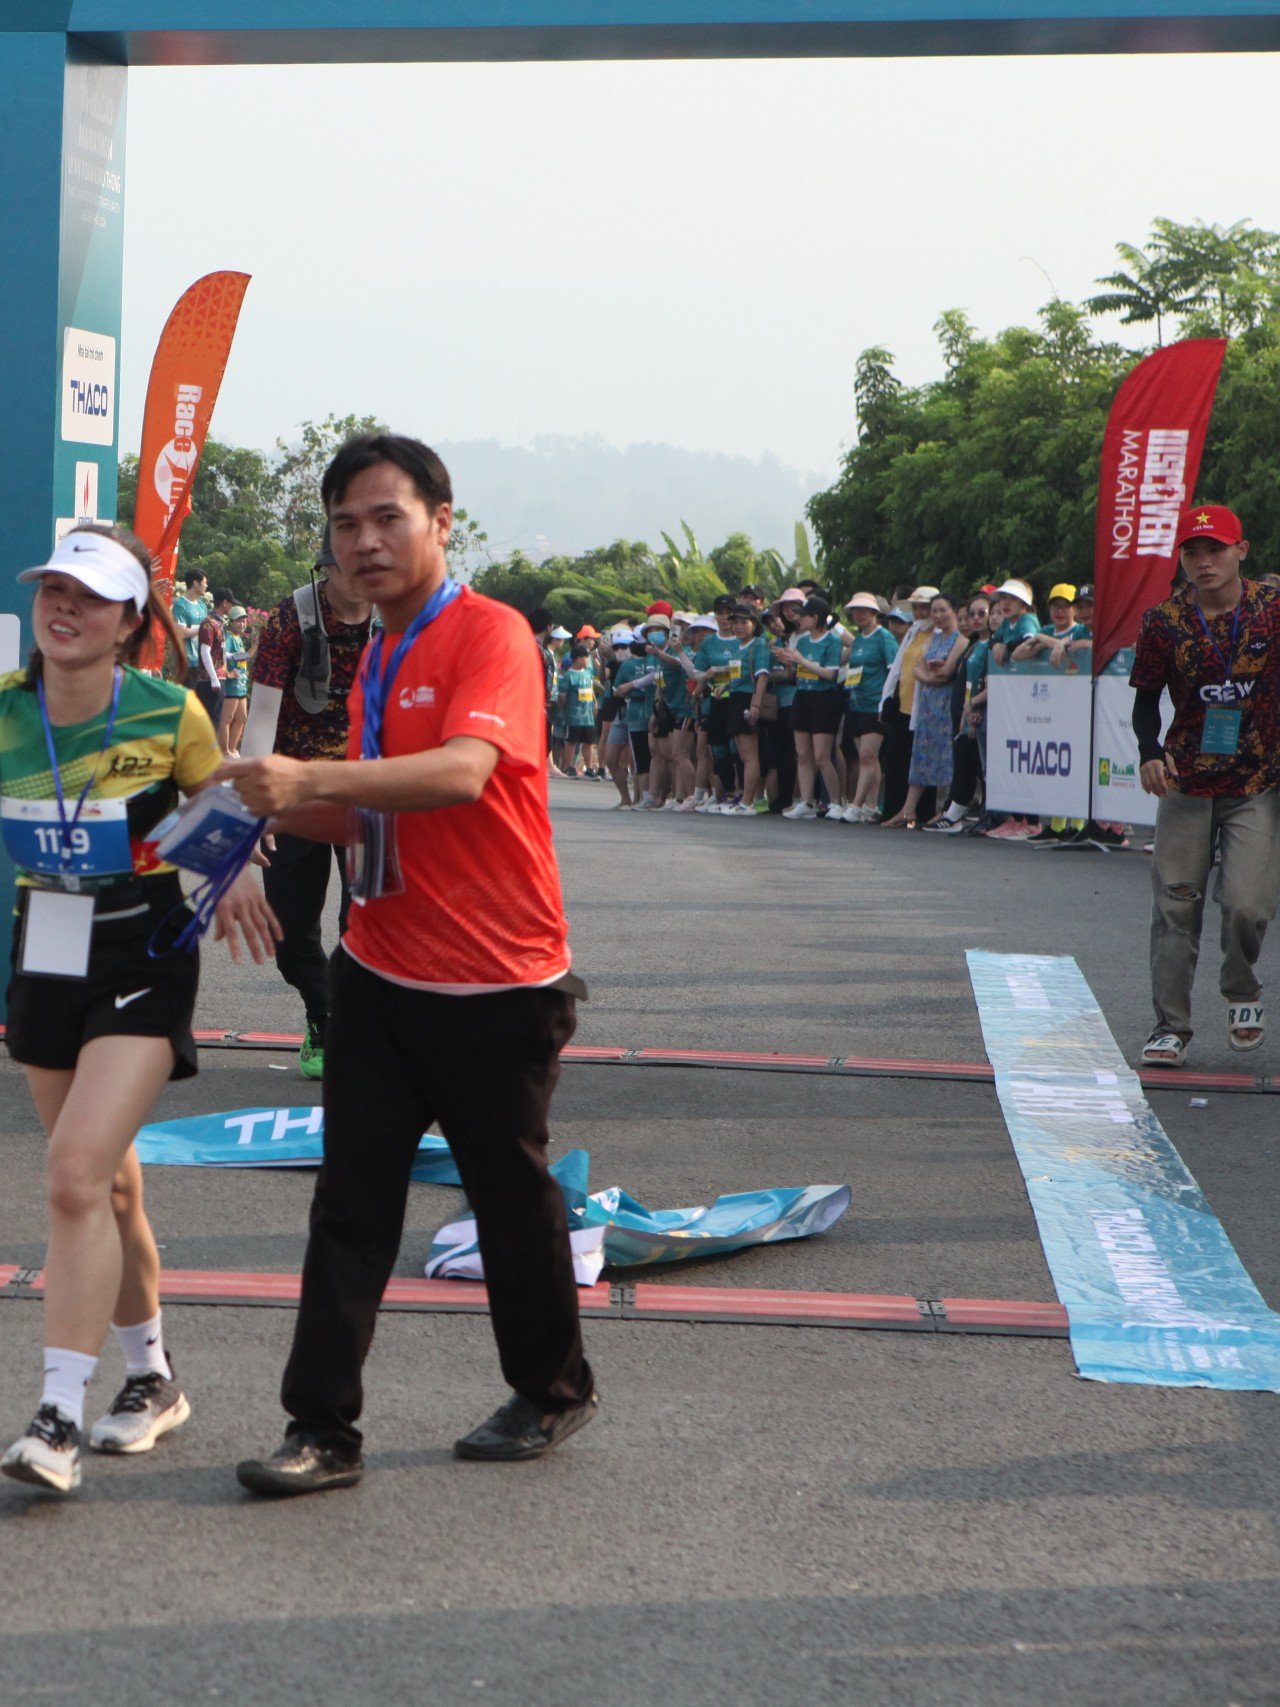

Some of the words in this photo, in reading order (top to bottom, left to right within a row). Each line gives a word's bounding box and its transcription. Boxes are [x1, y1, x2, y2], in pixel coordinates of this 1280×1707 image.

[70, 380, 108, 417] THACO
[174, 384, 202, 453] Race
[1112, 430, 1142, 560] MARATHON
[1136, 429, 1189, 558] DISCOVERY
[1200, 680, 1255, 703] CREW
[1006, 739, 1071, 777] THACO
[34, 828, 90, 855] 119
[224, 1106, 324, 1145] TH
